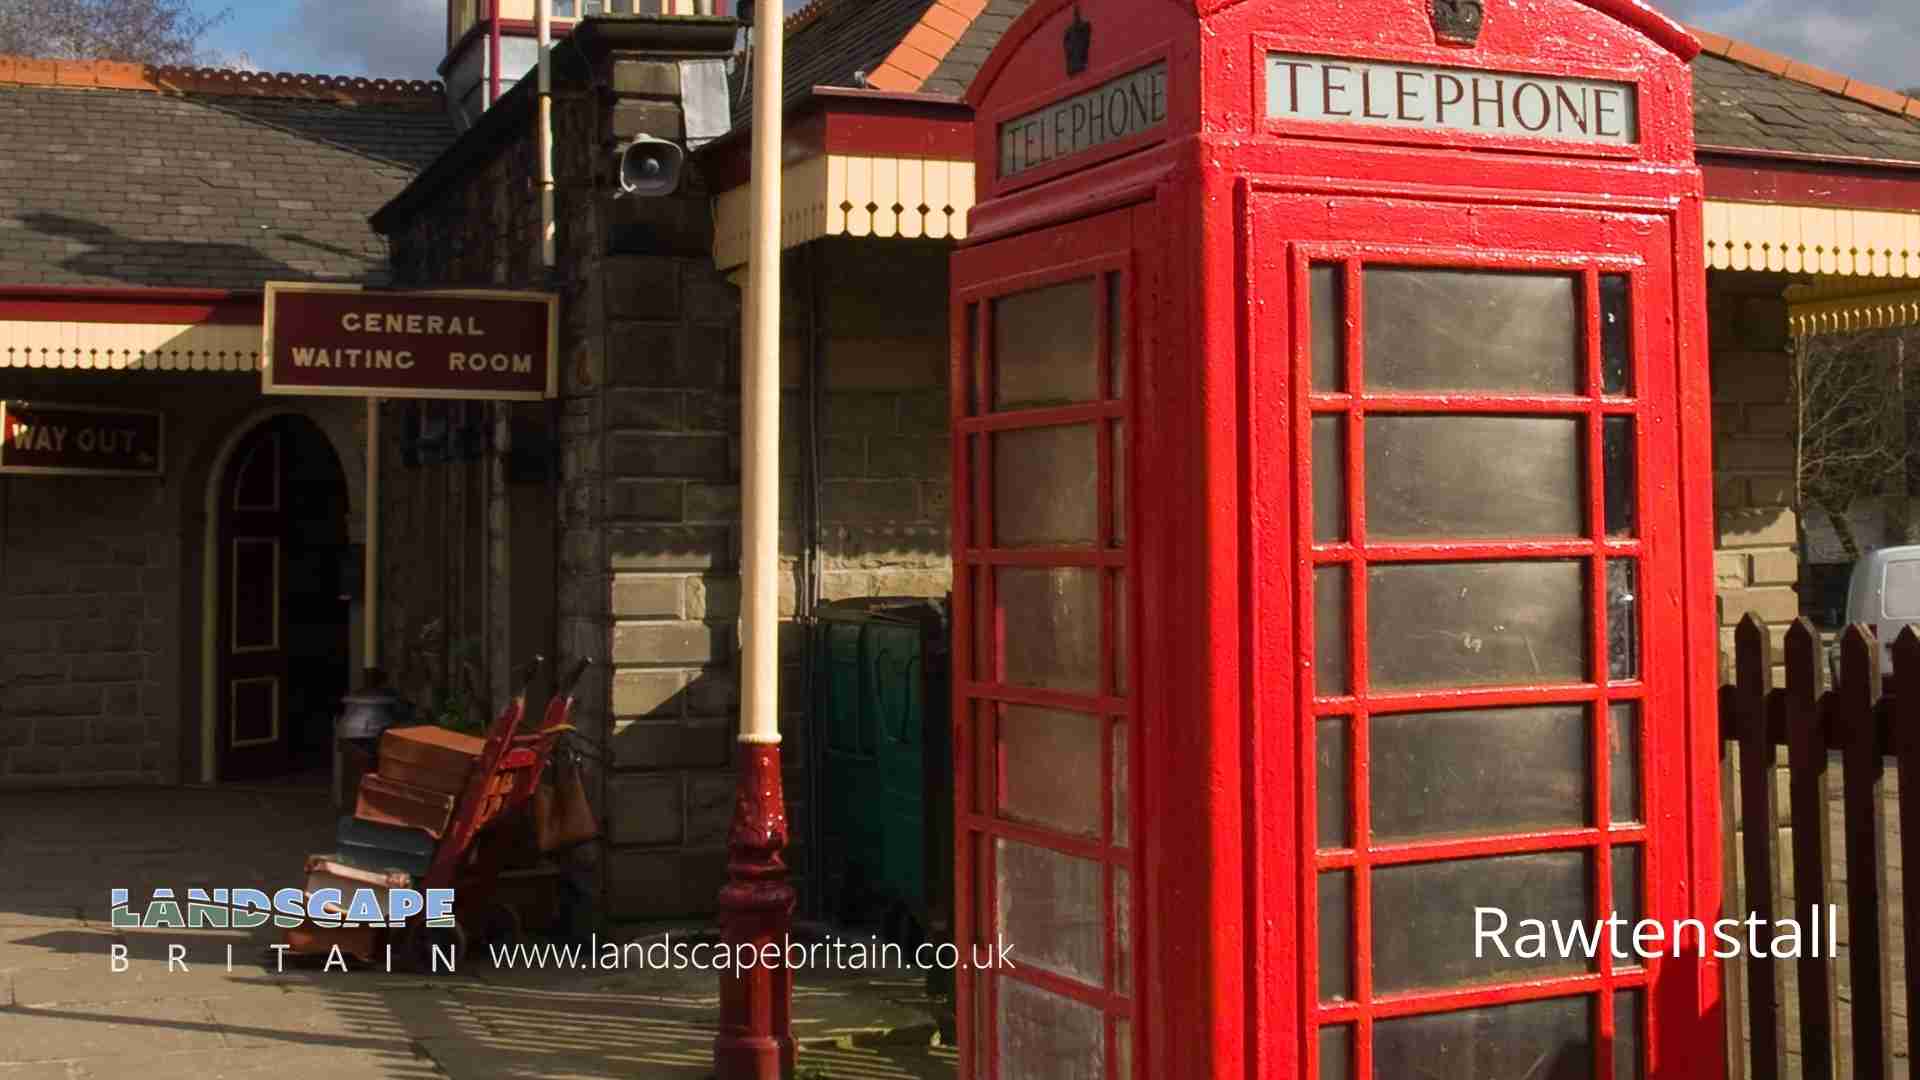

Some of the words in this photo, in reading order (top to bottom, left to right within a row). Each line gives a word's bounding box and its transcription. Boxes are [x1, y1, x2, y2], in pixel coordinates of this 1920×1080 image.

[1275, 61, 1621, 137] TELEPHONE
[1007, 70, 1167, 174] TELEPHONE
[341, 312, 486, 336] GENERAL
[291, 346, 416, 370] WAITING
[448, 352, 533, 374] ROOM
[11, 423, 69, 451] WAY
[76, 426, 137, 453] OUT
